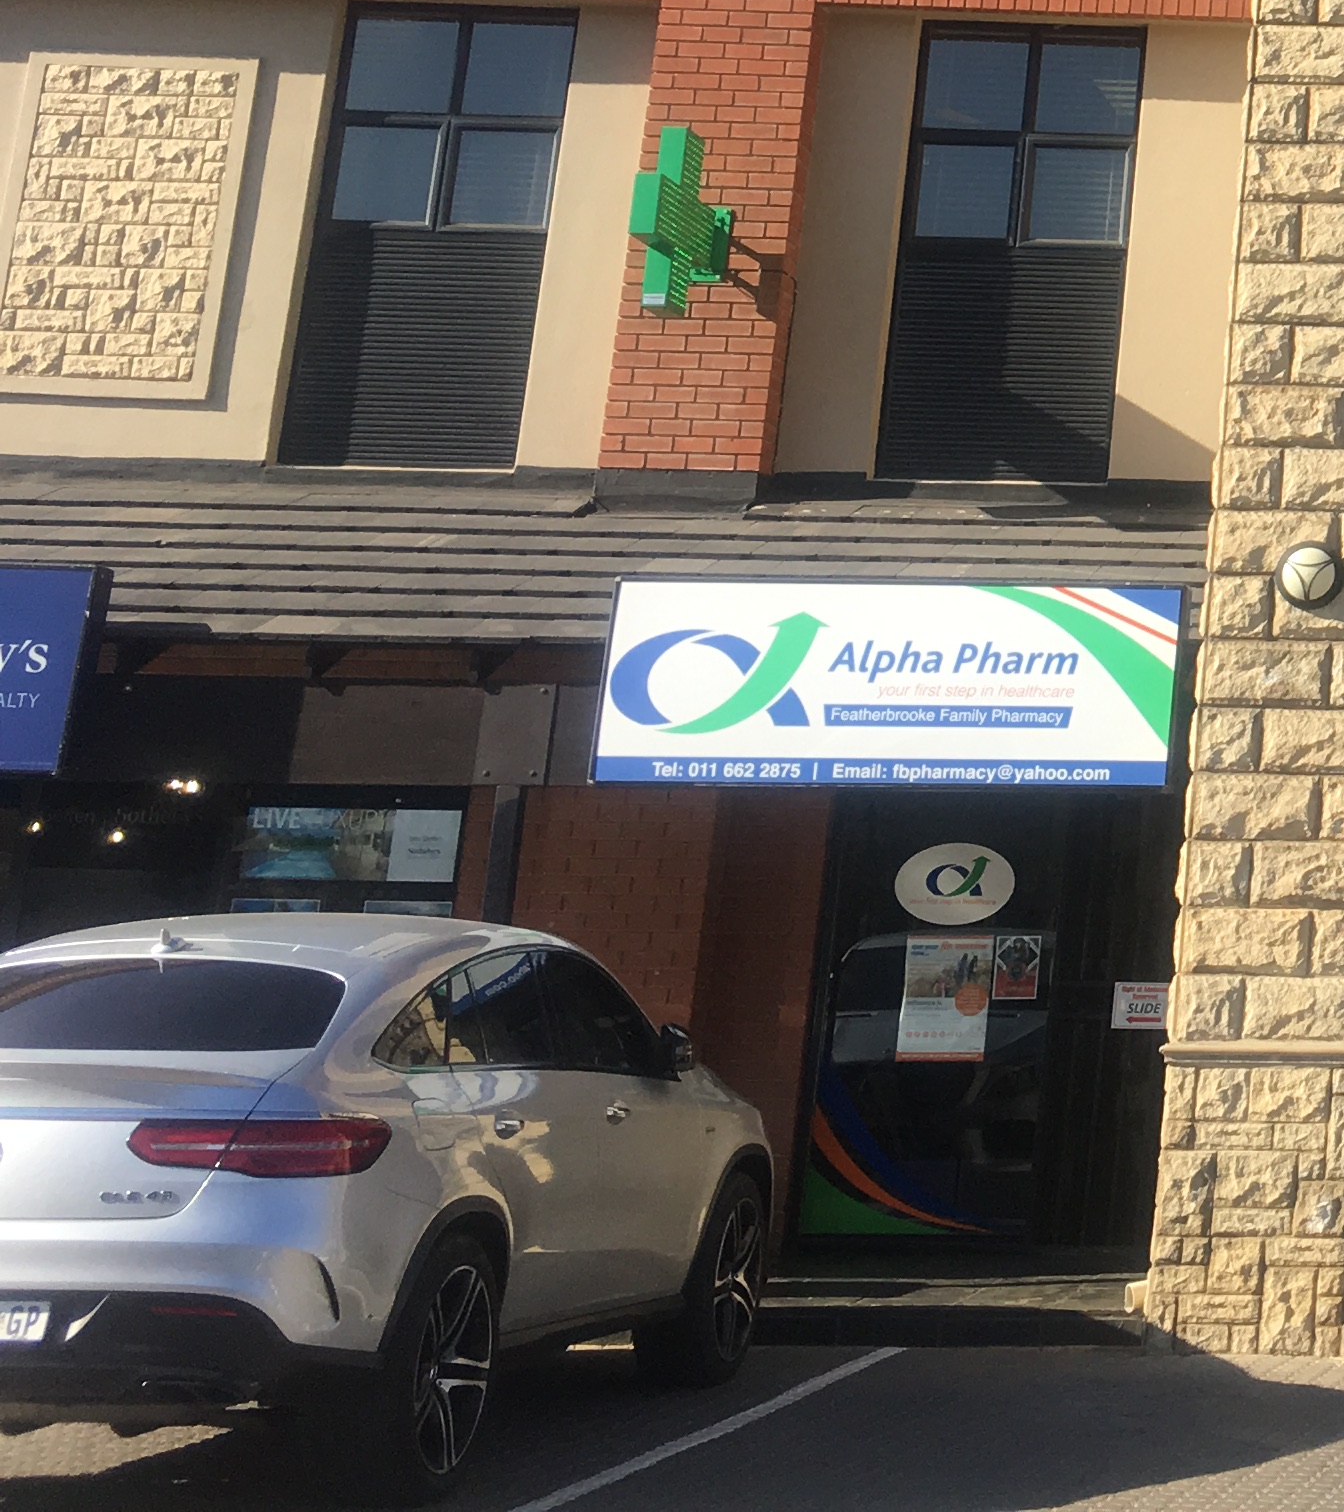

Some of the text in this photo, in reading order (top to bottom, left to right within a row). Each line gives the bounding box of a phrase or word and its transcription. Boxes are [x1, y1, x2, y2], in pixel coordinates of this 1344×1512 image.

[828, 639, 1080, 683] Alpha Pharm
[878, 682, 1076, 700] your first step in healthcare
[830, 706, 1064, 727] Featherbrooke Family Pharmacy
[651, 761, 683, 778] Tel:
[687, 762, 717, 778] 011
[722, 762, 756, 779] 662
[759, 763, 802, 779] 2875
[832, 763, 887, 780] Email:
[891, 764, 1111, 784] fbpharmacy@yahoo.com
[253, 806, 301, 829] LIVE
[1126, 1002, 1162, 1014] SLIDE
[6, 1304, 41, 1336] GP
